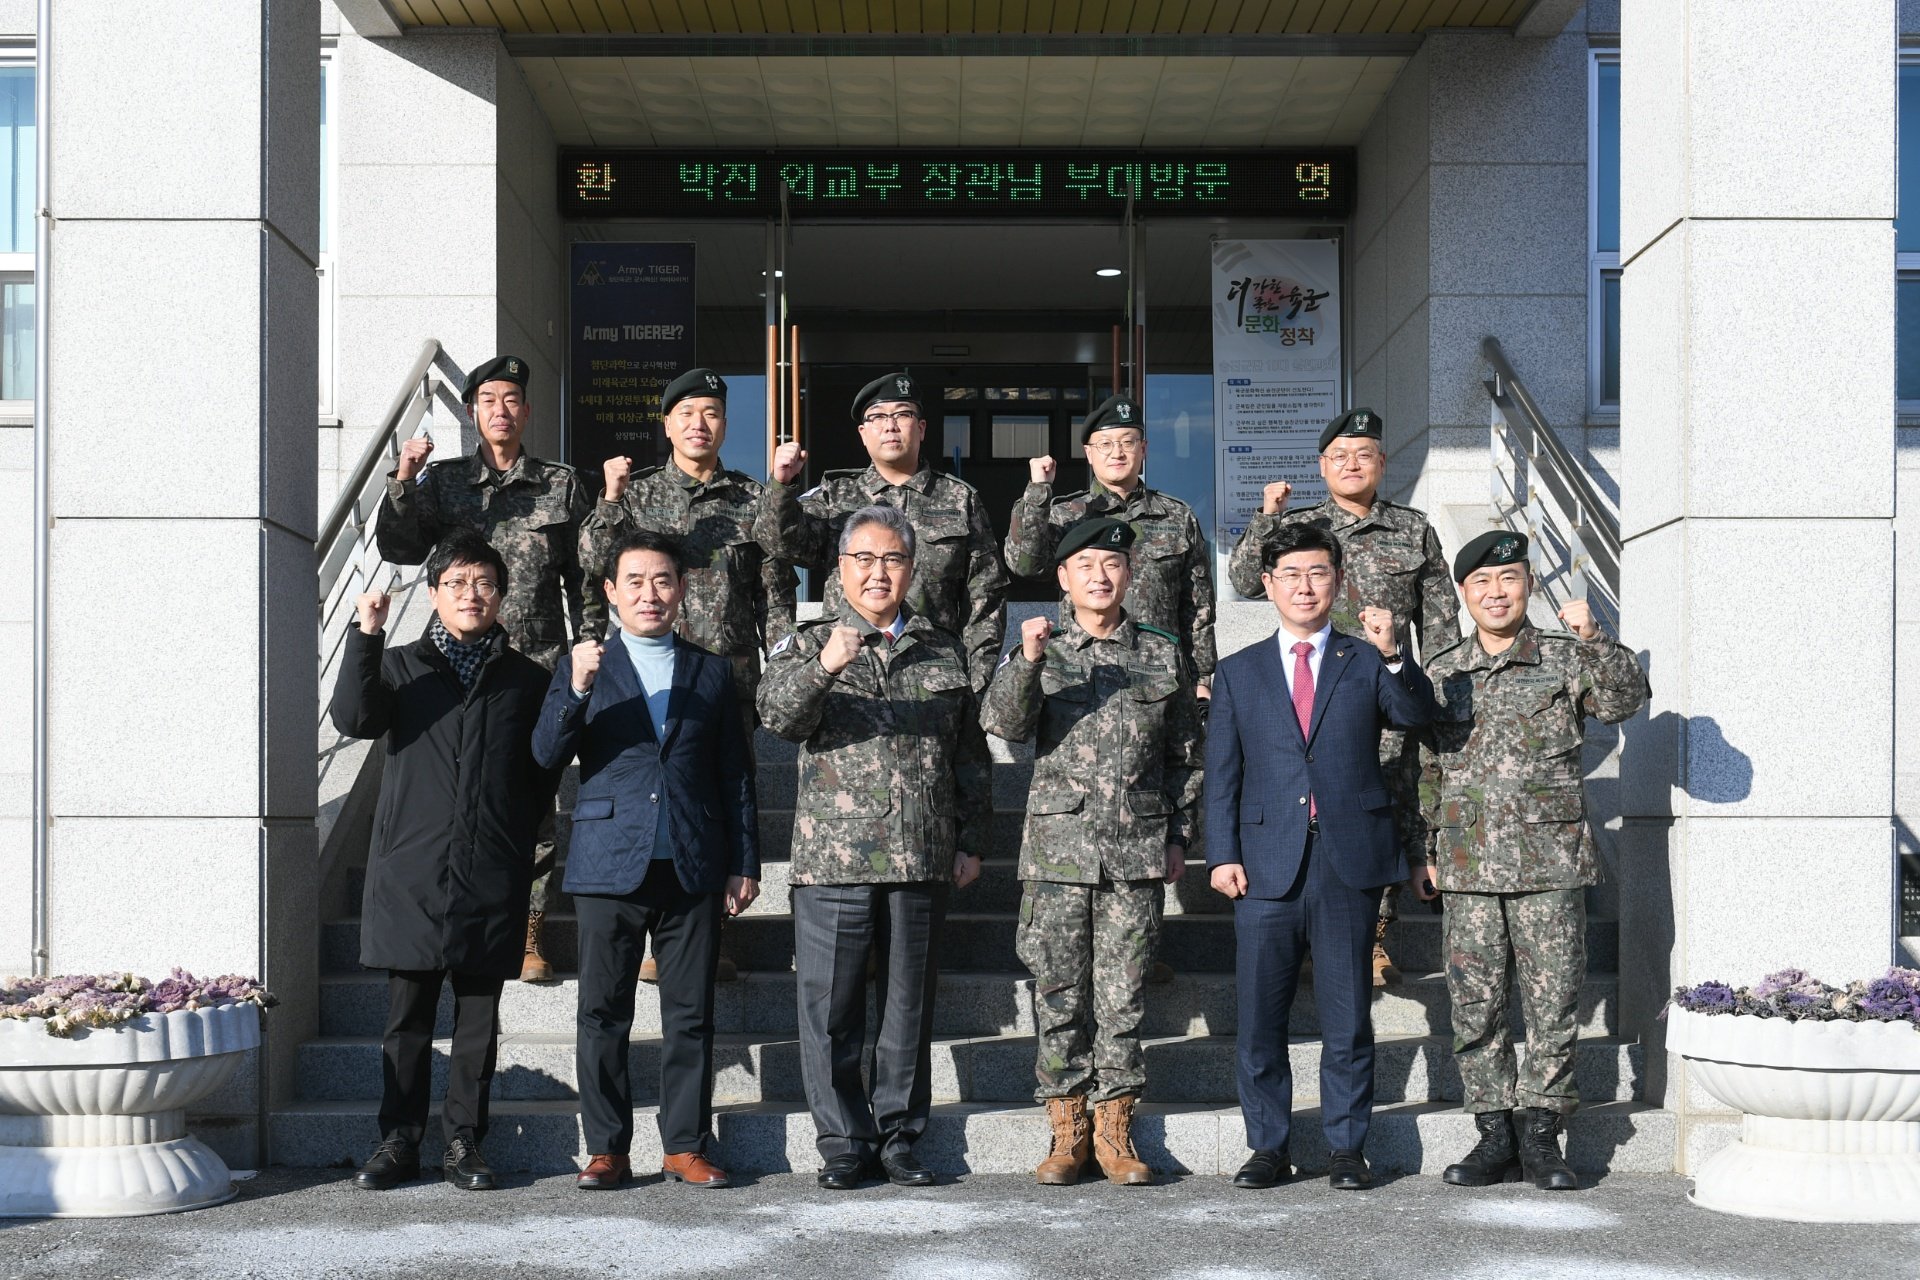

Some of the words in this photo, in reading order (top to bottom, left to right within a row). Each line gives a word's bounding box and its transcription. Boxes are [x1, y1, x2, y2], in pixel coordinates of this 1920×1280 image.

[577, 163, 616, 200] 환
[679, 163, 757, 200] 박진
[780, 163, 902, 200] 외교부
[922, 163, 1042, 200] 장관님
[1295, 163, 1330, 200] 영
[617, 264, 644, 276] Army
[648, 265, 681, 274] TIGER
[1227, 277, 1252, 327] 더
[1253, 278, 1282, 294] 강한
[1279, 286, 1330, 320] 육군
[583, 325, 619, 342] Army
[622, 324, 684, 341] TIGER란?
[1245, 314, 1280, 334] 문화
[1280, 327, 1315, 346] 정착
[596, 412, 614, 423] 미래
